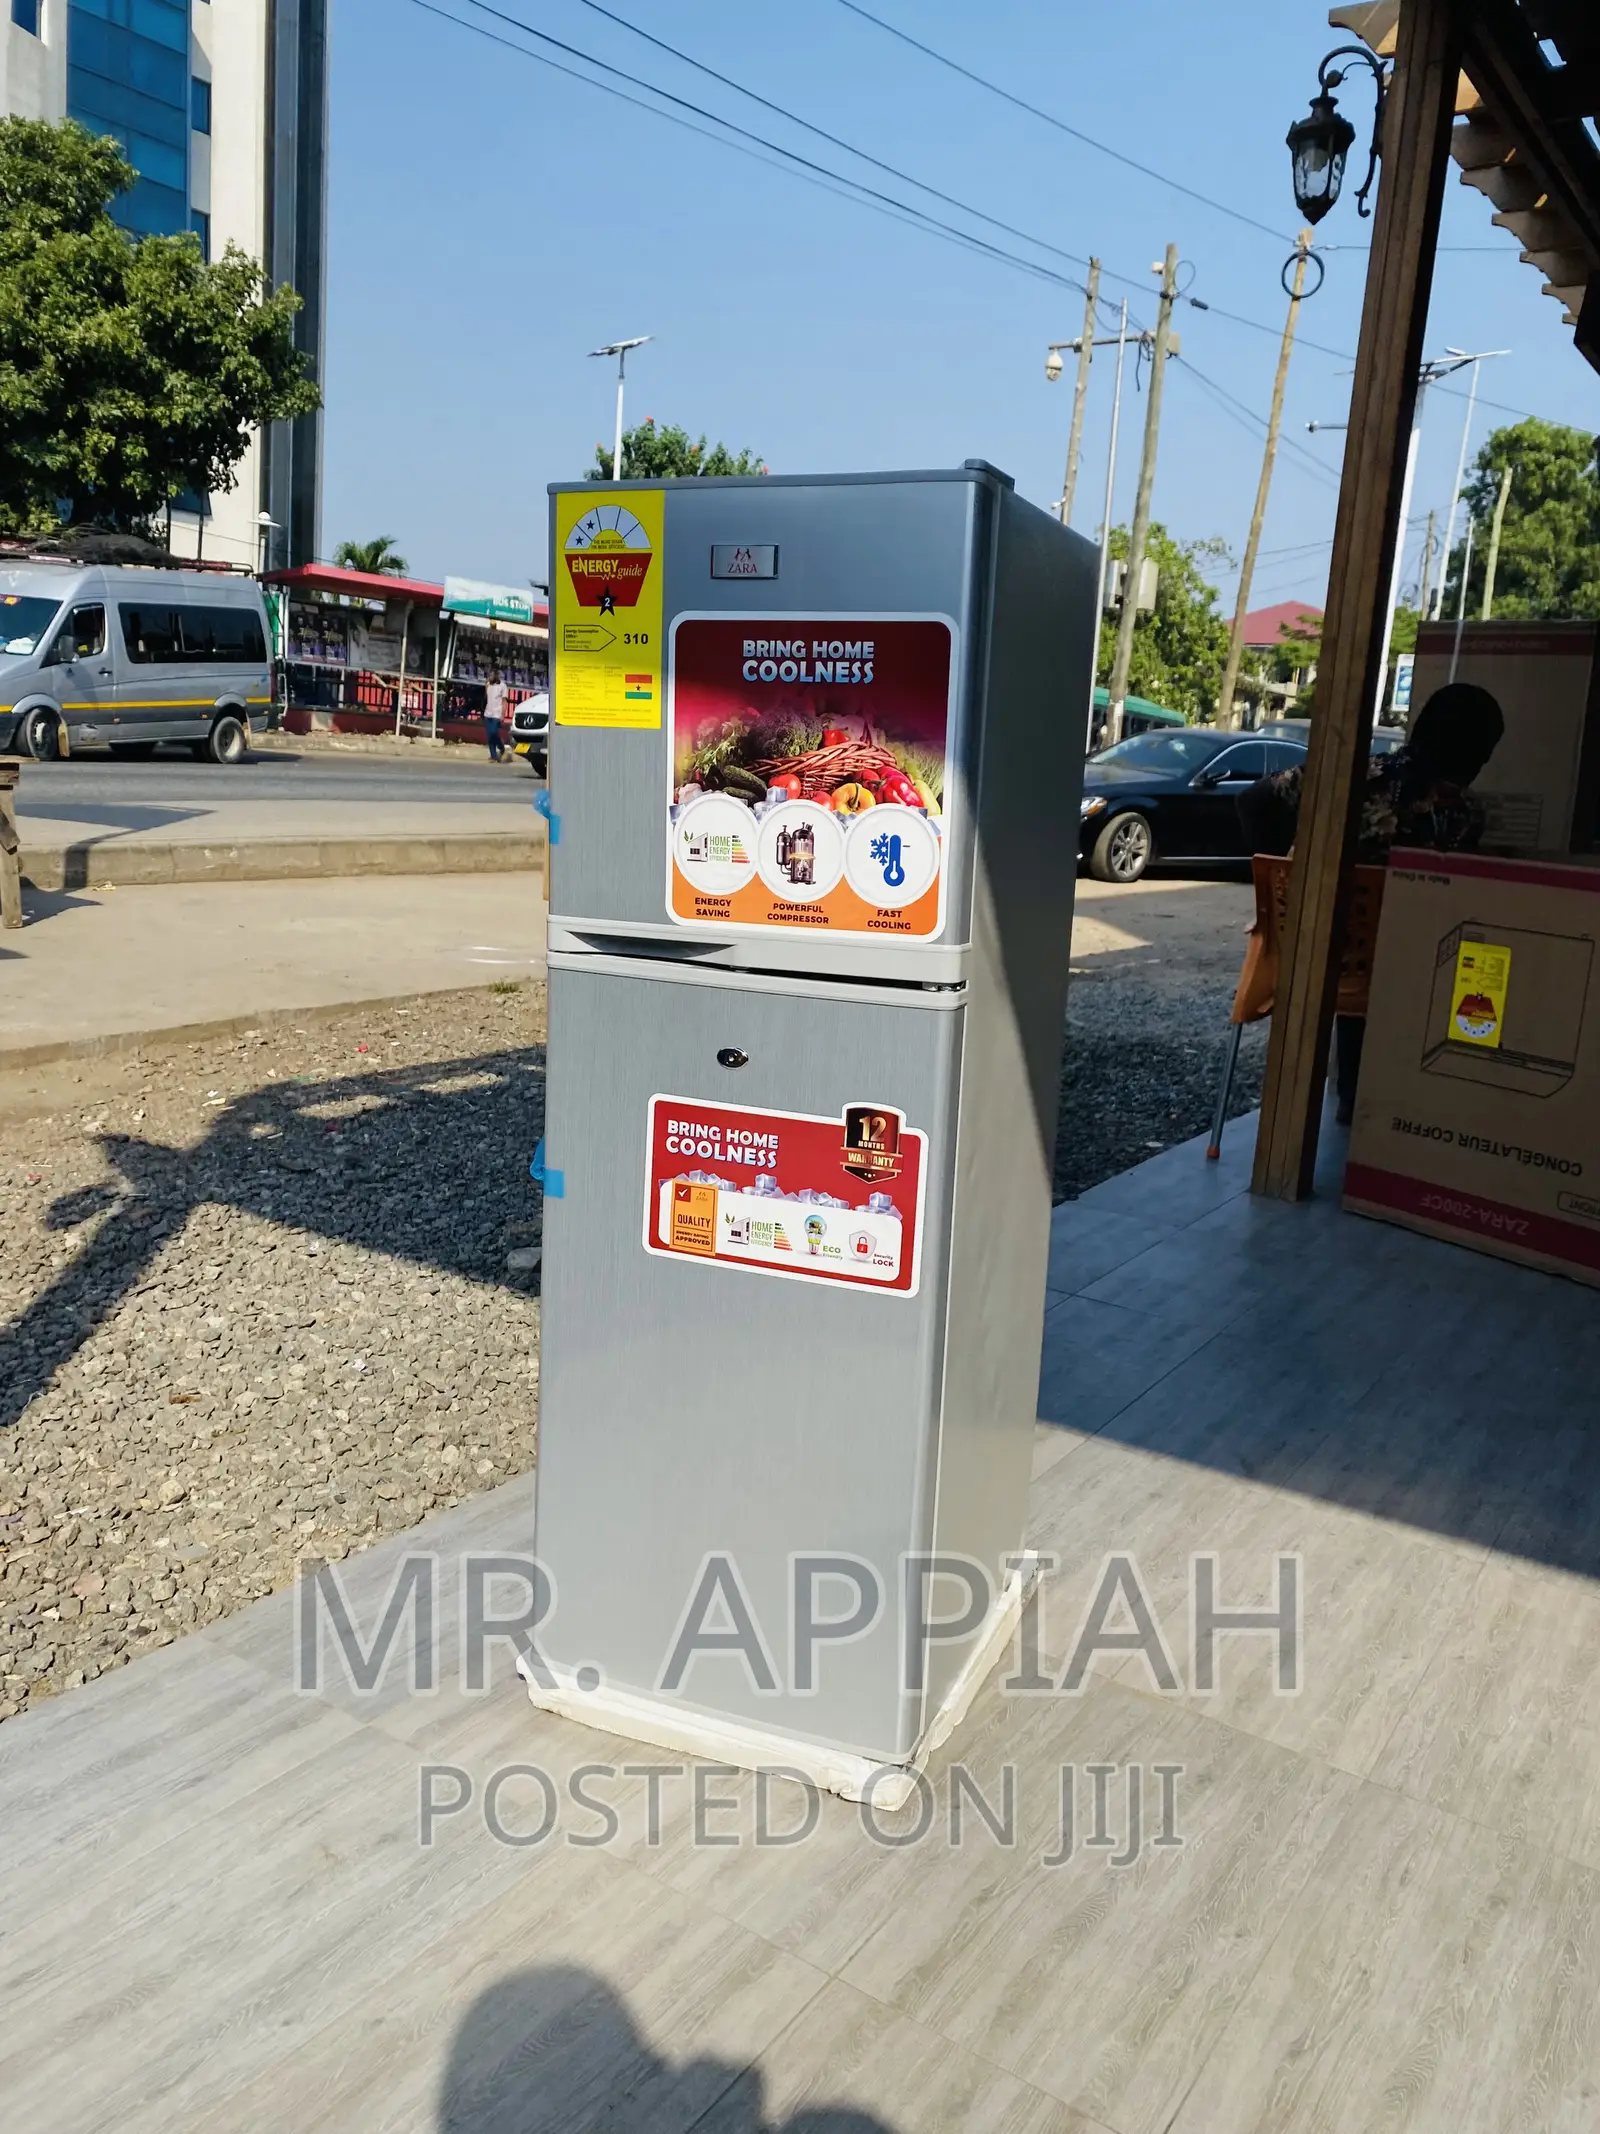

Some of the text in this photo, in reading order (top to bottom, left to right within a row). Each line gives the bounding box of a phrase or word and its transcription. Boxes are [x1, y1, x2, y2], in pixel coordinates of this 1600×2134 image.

[572, 557, 643, 579] ENERGY guide
[727, 563, 758, 573] ZARA
[604, 598, 611, 607] 2
[624, 633, 649, 645] 310
[743, 640, 875, 659] BRING HOME
[742, 660, 874, 684] COOLNESS
[710, 836, 731, 846] HOME
[695, 897, 732, 907] ENERGY
[773, 902, 824, 913] POWERFUL
[696, 908, 731, 918] SAVING
[767, 913, 829, 924] COMPRESSOR
[877, 909, 903, 918] FAST
[867, 919, 911, 930] COOLING
[667, 1119, 779, 1149] BRING HOME
[859, 1116, 887, 1141] 12
[858, 1140, 885, 1150] MONTHS
[1391, 1116, 1583, 1177] CONGÉLATEUR COFFRE
[665, 1135, 777, 1168] COOLNESS
[1419, 1192, 1530, 1236] ZARA-200CF
[677, 1214, 711, 1228] QUALITY
[751, 1220, 774, 1233] HOME
[675, 1235, 711, 1246] APPROVED
[751, 1230, 773, 1241] ENERGY
[822, 1245, 841, 1253] ECO
[872, 1258, 894, 1267] LOCK
